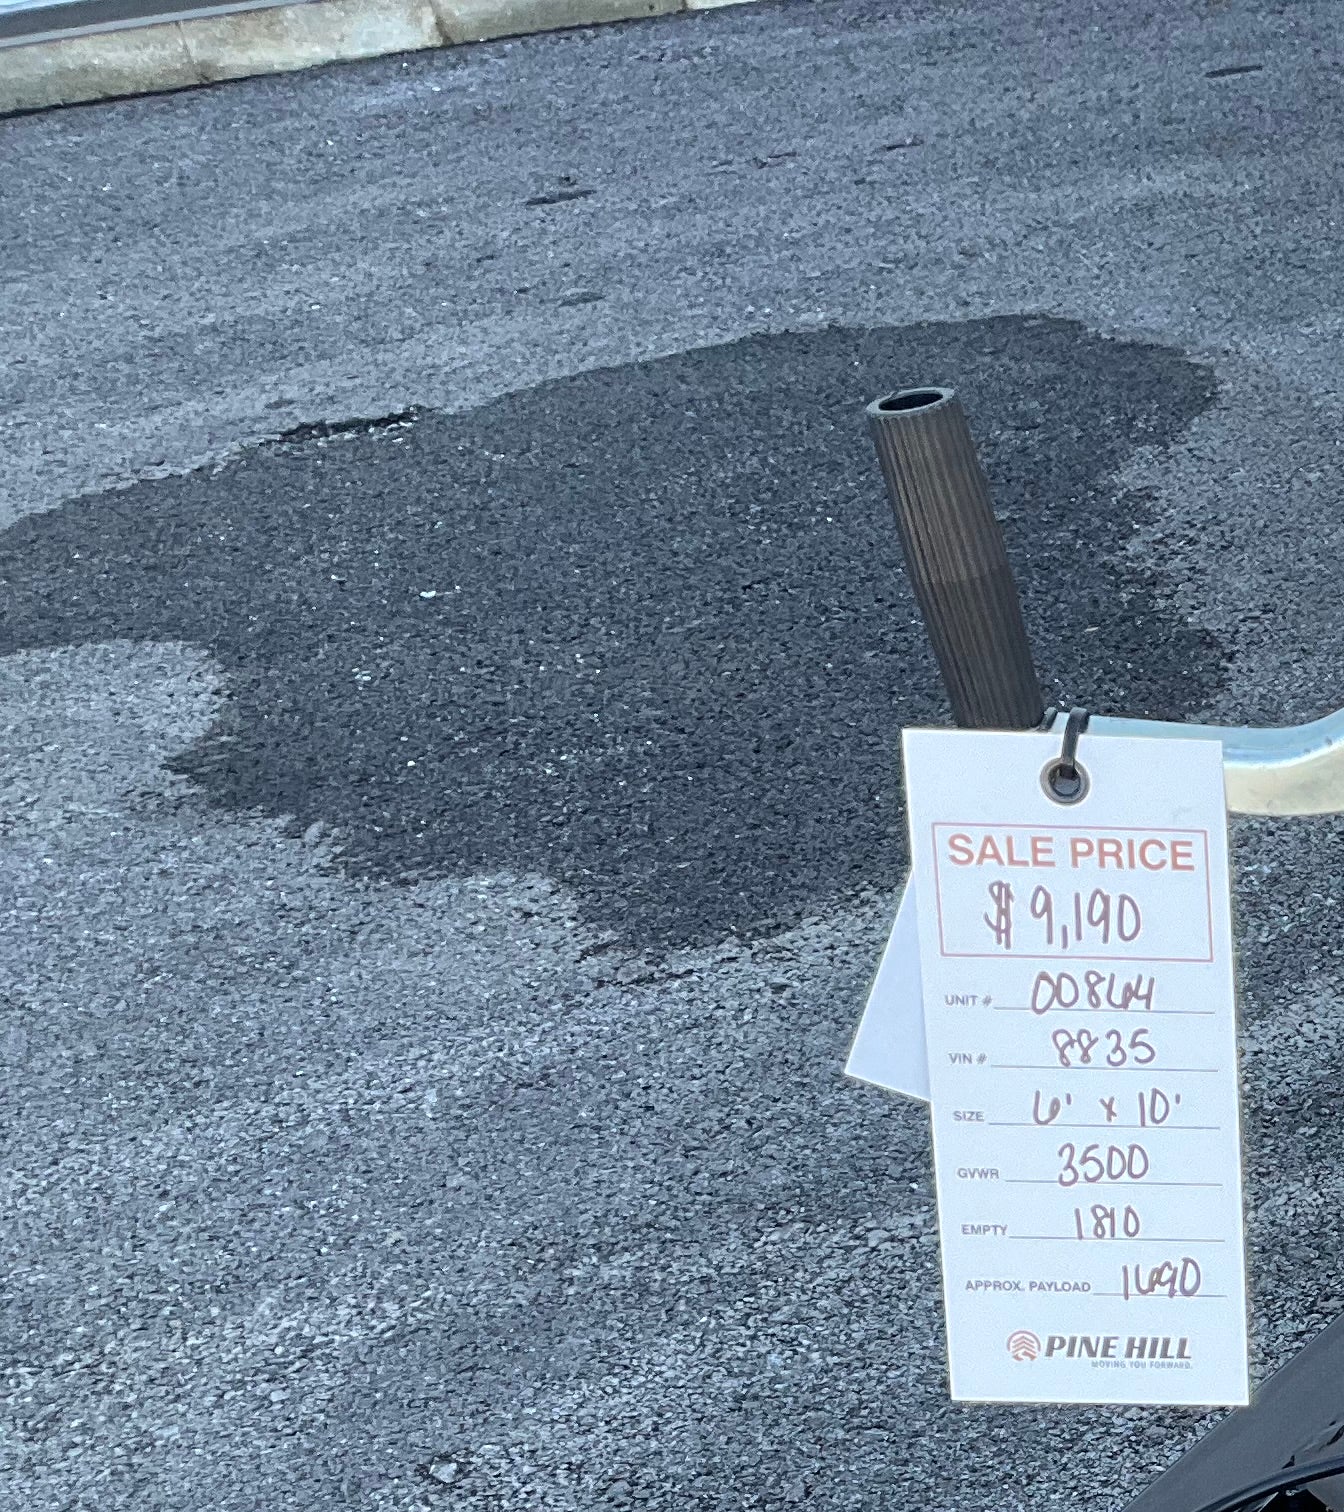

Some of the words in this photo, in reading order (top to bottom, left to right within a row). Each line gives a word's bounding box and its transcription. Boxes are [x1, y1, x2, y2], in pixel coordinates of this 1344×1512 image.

[948, 833, 1056, 868] SALE
[1070, 837, 1195, 871] PRICE
[1030, 885, 1141, 949] 9,190
[944, 995, 979, 1007] UNIT
[949, 1053, 973, 1064] VIN
[1052, 1028, 1156, 1068] 8835
[953, 1111, 984, 1122] SIZE
[958, 1168, 999, 1179] GVWR
[1058, 1143, 1149, 1187] 3500
[961, 1224, 1008, 1236] EMPTY
[1075, 1204, 1140, 1240] 1810
[965, 1280, 1025, 1292] APPROX.
[1029, 1281, 1091, 1293] PAYLOAD
[1045, 1335, 1118, 1358] PINE
[1125, 1337, 1191, 1359] HILL
